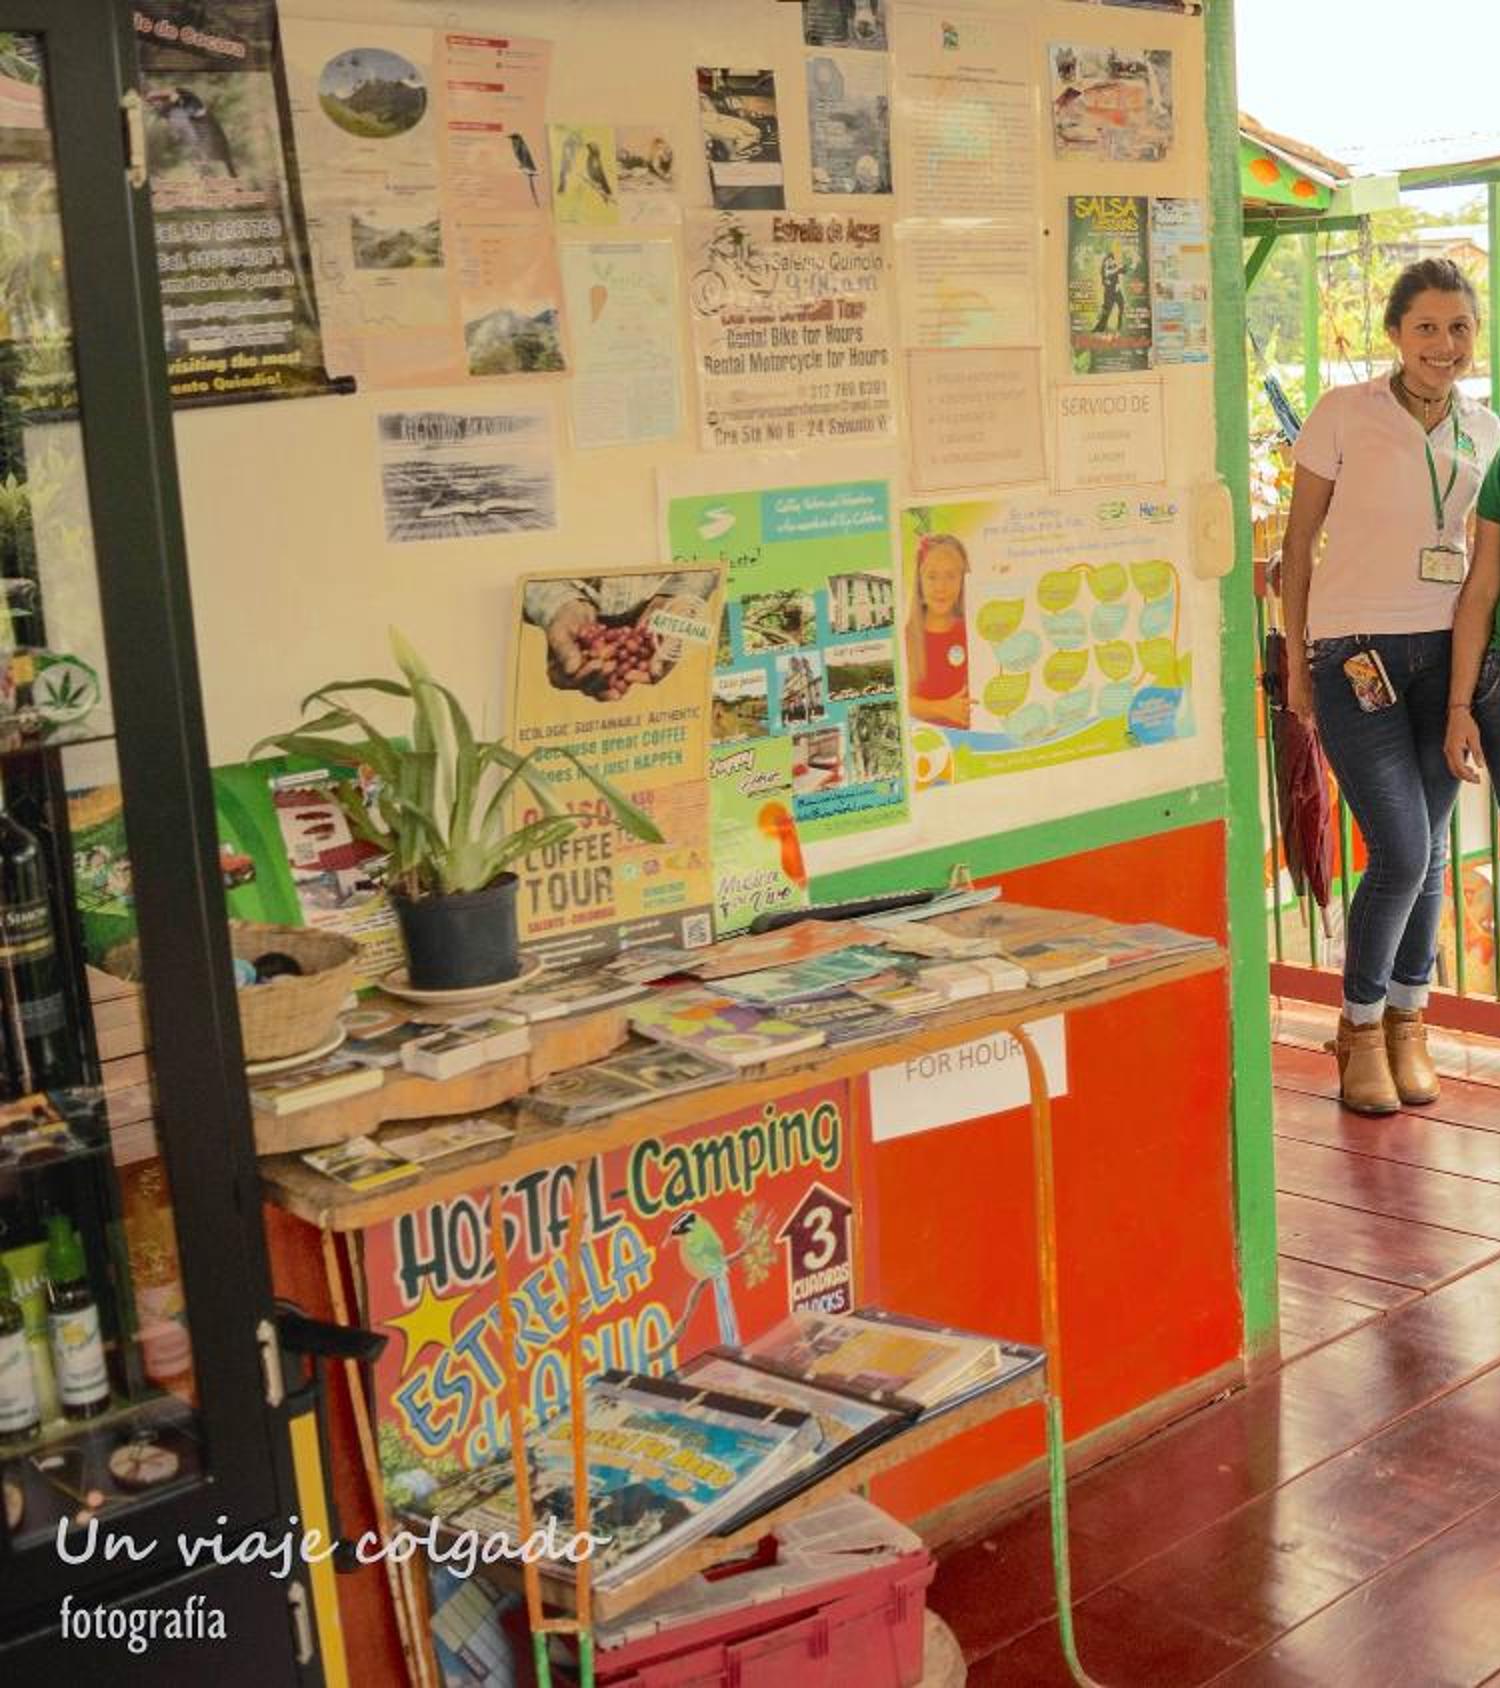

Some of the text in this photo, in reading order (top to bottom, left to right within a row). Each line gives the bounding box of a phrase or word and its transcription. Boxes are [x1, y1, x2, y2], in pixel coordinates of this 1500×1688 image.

[1074, 196, 1140, 219] SALSA
[773, 216, 824, 243] Estrella
[847, 216, 881, 249] Agua
[771, 326, 799, 348] Bike
[802, 324, 822, 346] for
[825, 323, 864, 345] Hours
[231, 352, 258, 368] the
[704, 346, 890, 377] Rental Motorcycle for Hours
[1130, 394, 1152, 414] DE
[642, 726, 688, 747] COFFEE
[525, 865, 615, 914] TOUR
[906, 1034, 1031, 1083] FOR HOUR
[630, 1102, 839, 1216] Camping
[803, 1205, 838, 1271] 3
